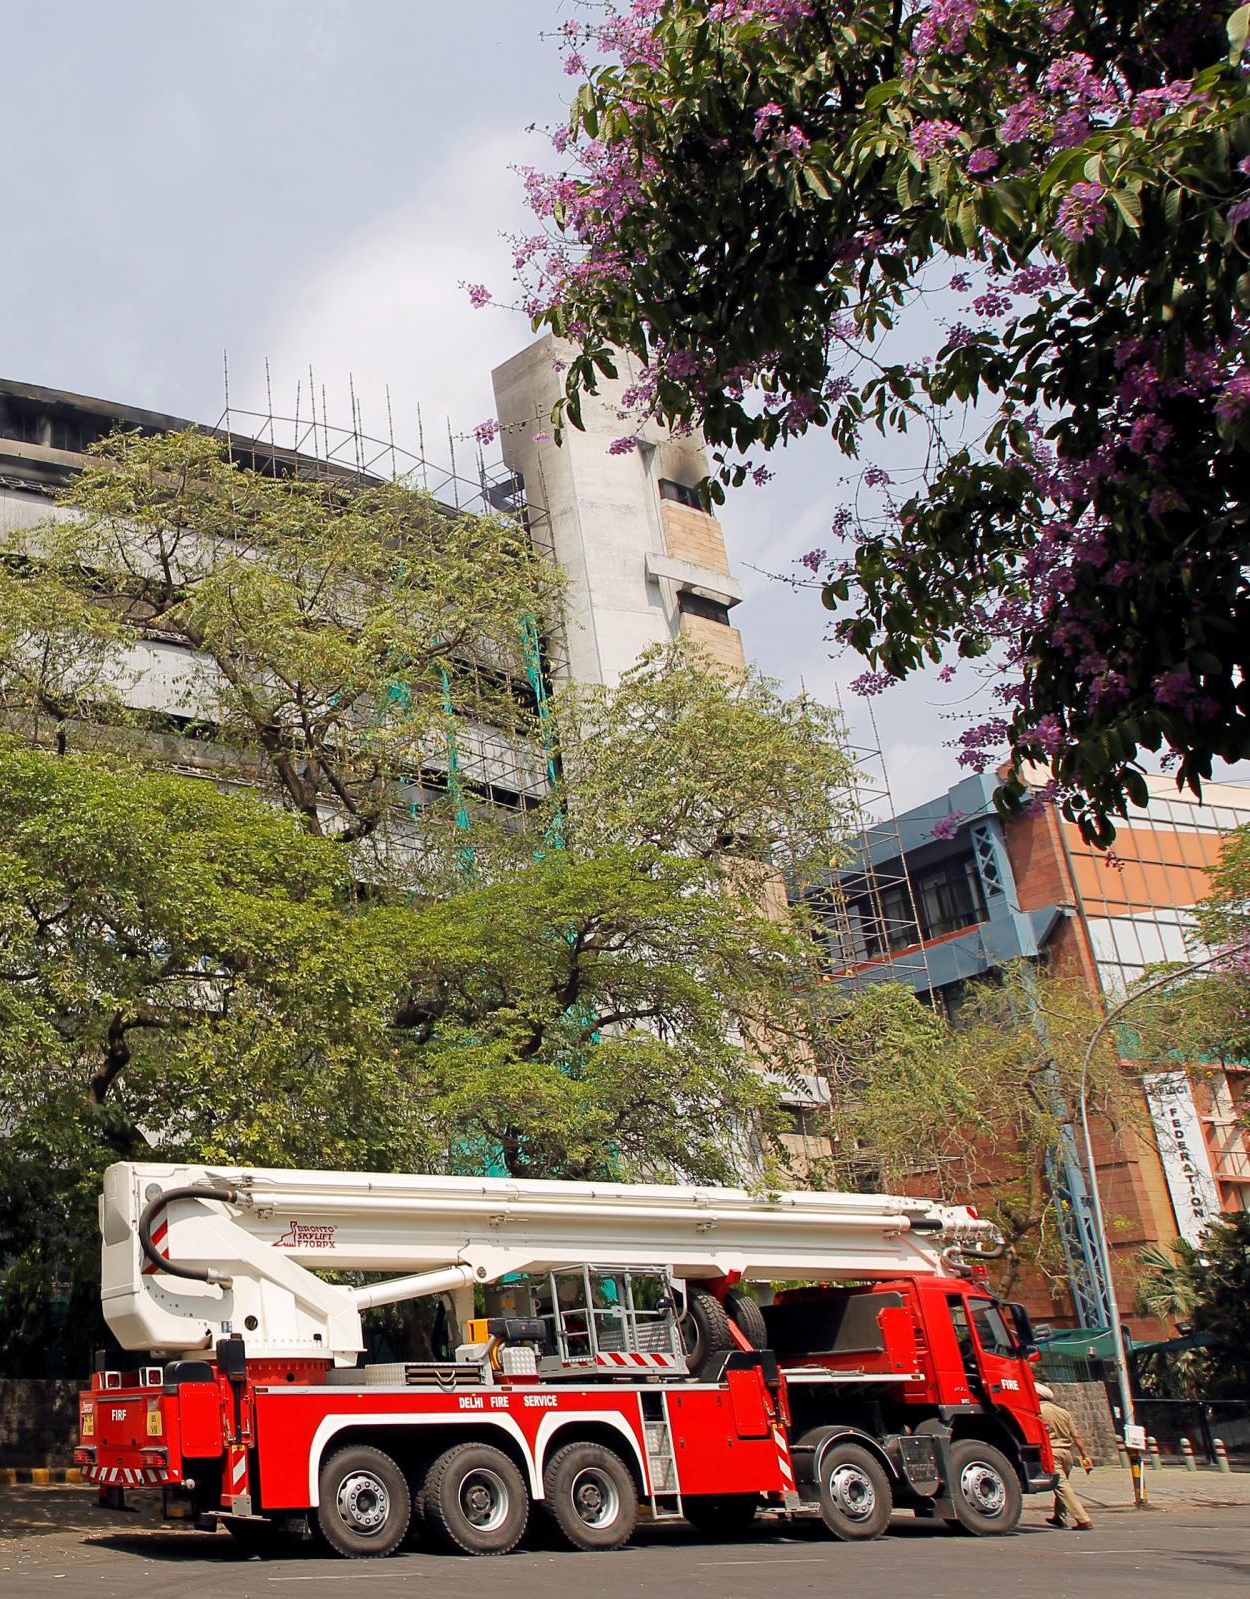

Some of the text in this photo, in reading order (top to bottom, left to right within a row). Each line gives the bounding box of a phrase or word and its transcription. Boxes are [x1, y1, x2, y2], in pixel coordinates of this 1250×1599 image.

[1169, 1108, 1204, 1218] FEDERATION
[297, 1225, 335, 1233] BRONTO
[297, 1232, 334, 1240] SKYLIFT
[1000, 1379, 1020, 1391] FIRE
[459, 1395, 558, 1409] DELHI FIRE SERVICE
